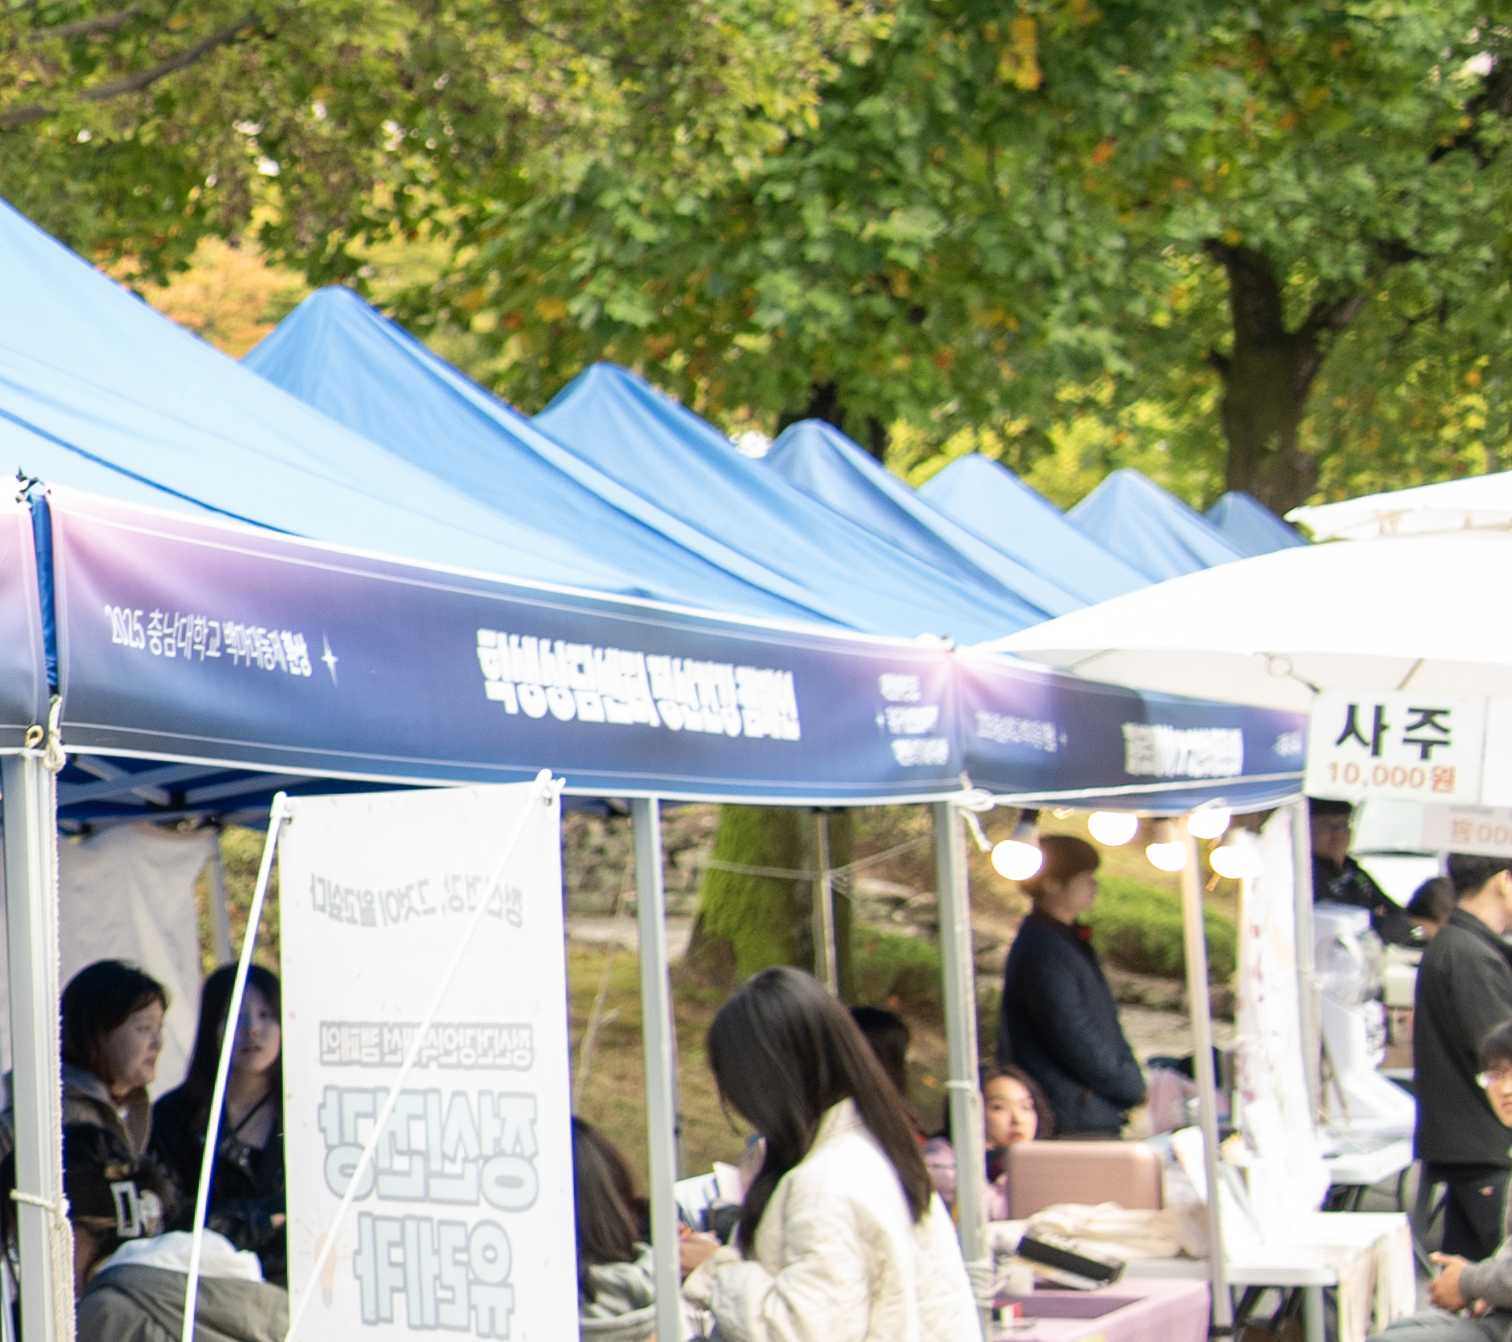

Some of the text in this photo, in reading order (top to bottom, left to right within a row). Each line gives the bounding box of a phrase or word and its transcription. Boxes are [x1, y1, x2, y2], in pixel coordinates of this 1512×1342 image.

[103, 604, 146, 650] 2025
[147, 609, 222, 662] 충남대학교
[1335, 702, 1453, 759] 사주
[1326, 759, 1457, 794] 10,000원
